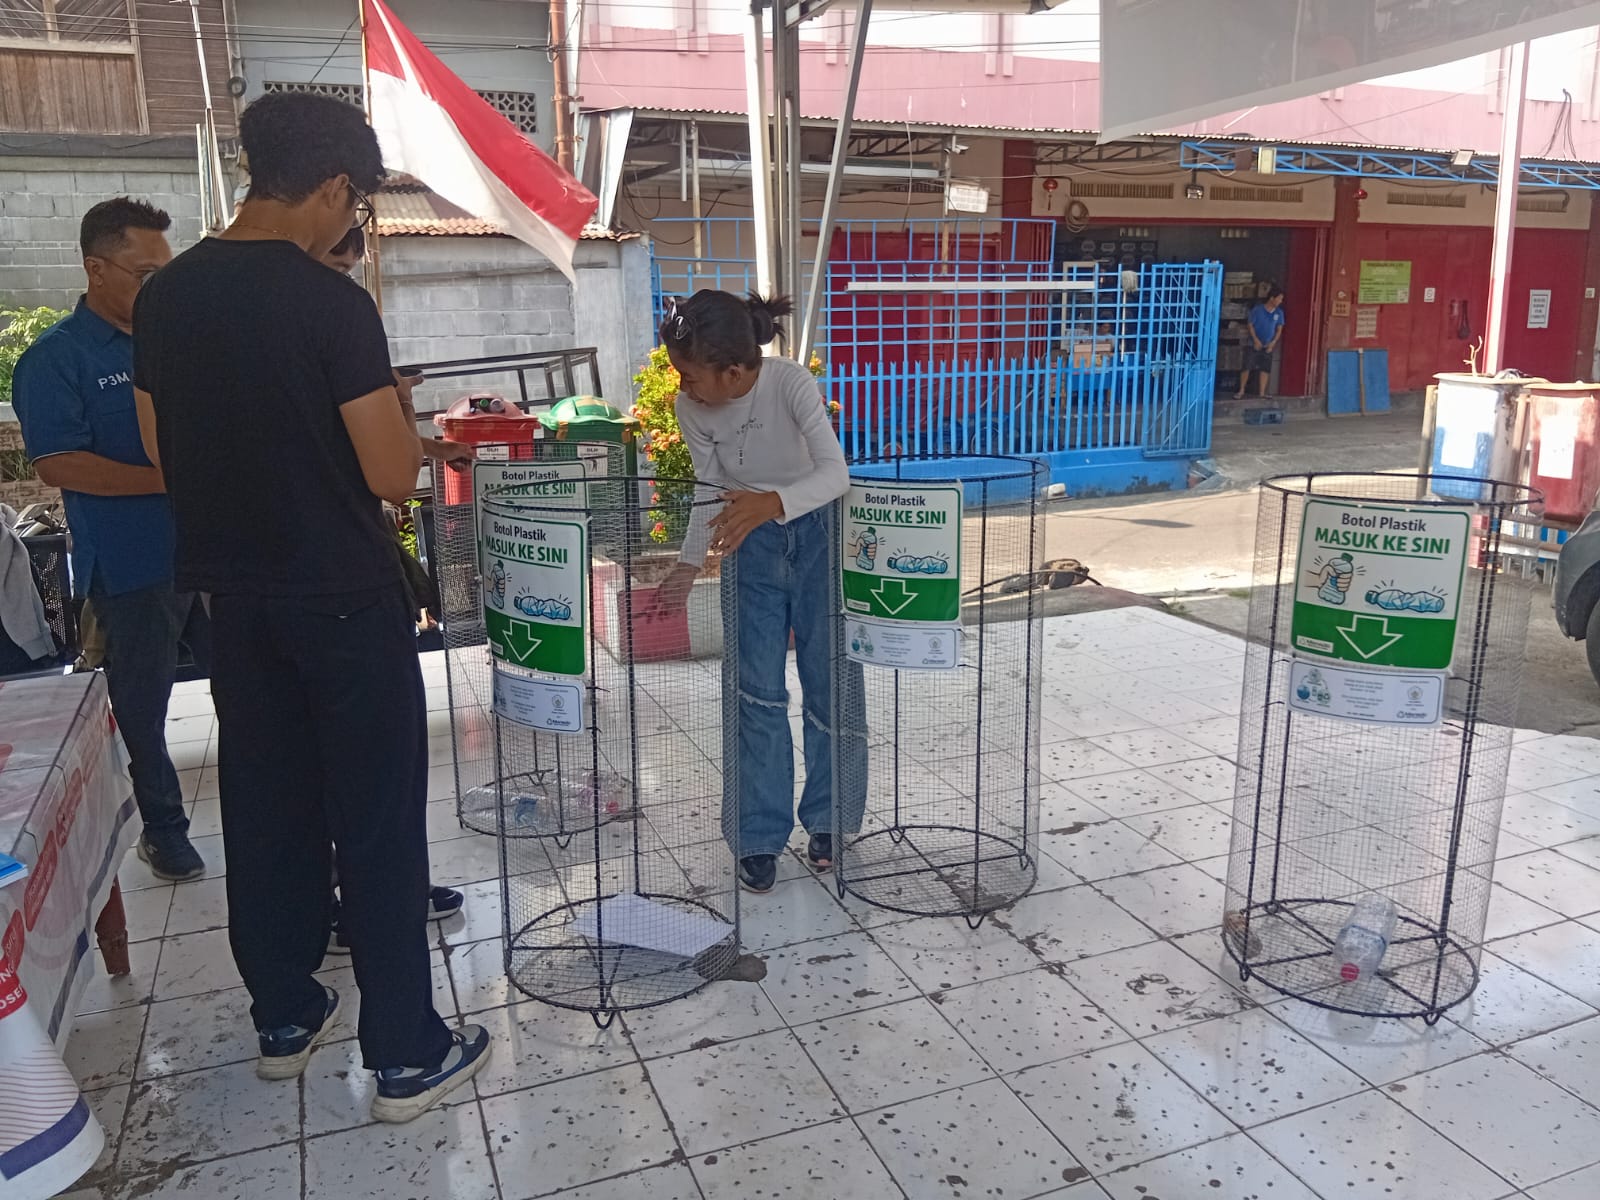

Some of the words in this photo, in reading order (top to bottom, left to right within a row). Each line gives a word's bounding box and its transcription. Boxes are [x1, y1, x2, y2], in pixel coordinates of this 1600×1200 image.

[97, 371, 131, 390] P3M
[502, 470, 527, 481] Botol
[529, 469, 560, 480] Plastik
[533, 483, 550, 495] KE
[551, 482, 576, 495] SINI
[865, 493, 889, 506] Botol
[891, 494, 926, 507] Plastik
[849, 505, 892, 523] MASUK
[895, 510, 914, 524] KE
[916, 510, 947, 525] SINI
[1341, 513, 1376, 528] Botol
[1379, 516, 1427, 532] Plastik
[494, 521, 513, 538] Botol
[513, 524, 547, 542] Plastik
[1314, 527, 1380, 550] MASUK
[1382, 535, 1407, 552] KE
[1411, 536, 1451, 555] SINI
[485, 535, 517, 559] MASUK
[517, 543, 536, 561] KE
[537, 545, 569, 565] SINI
